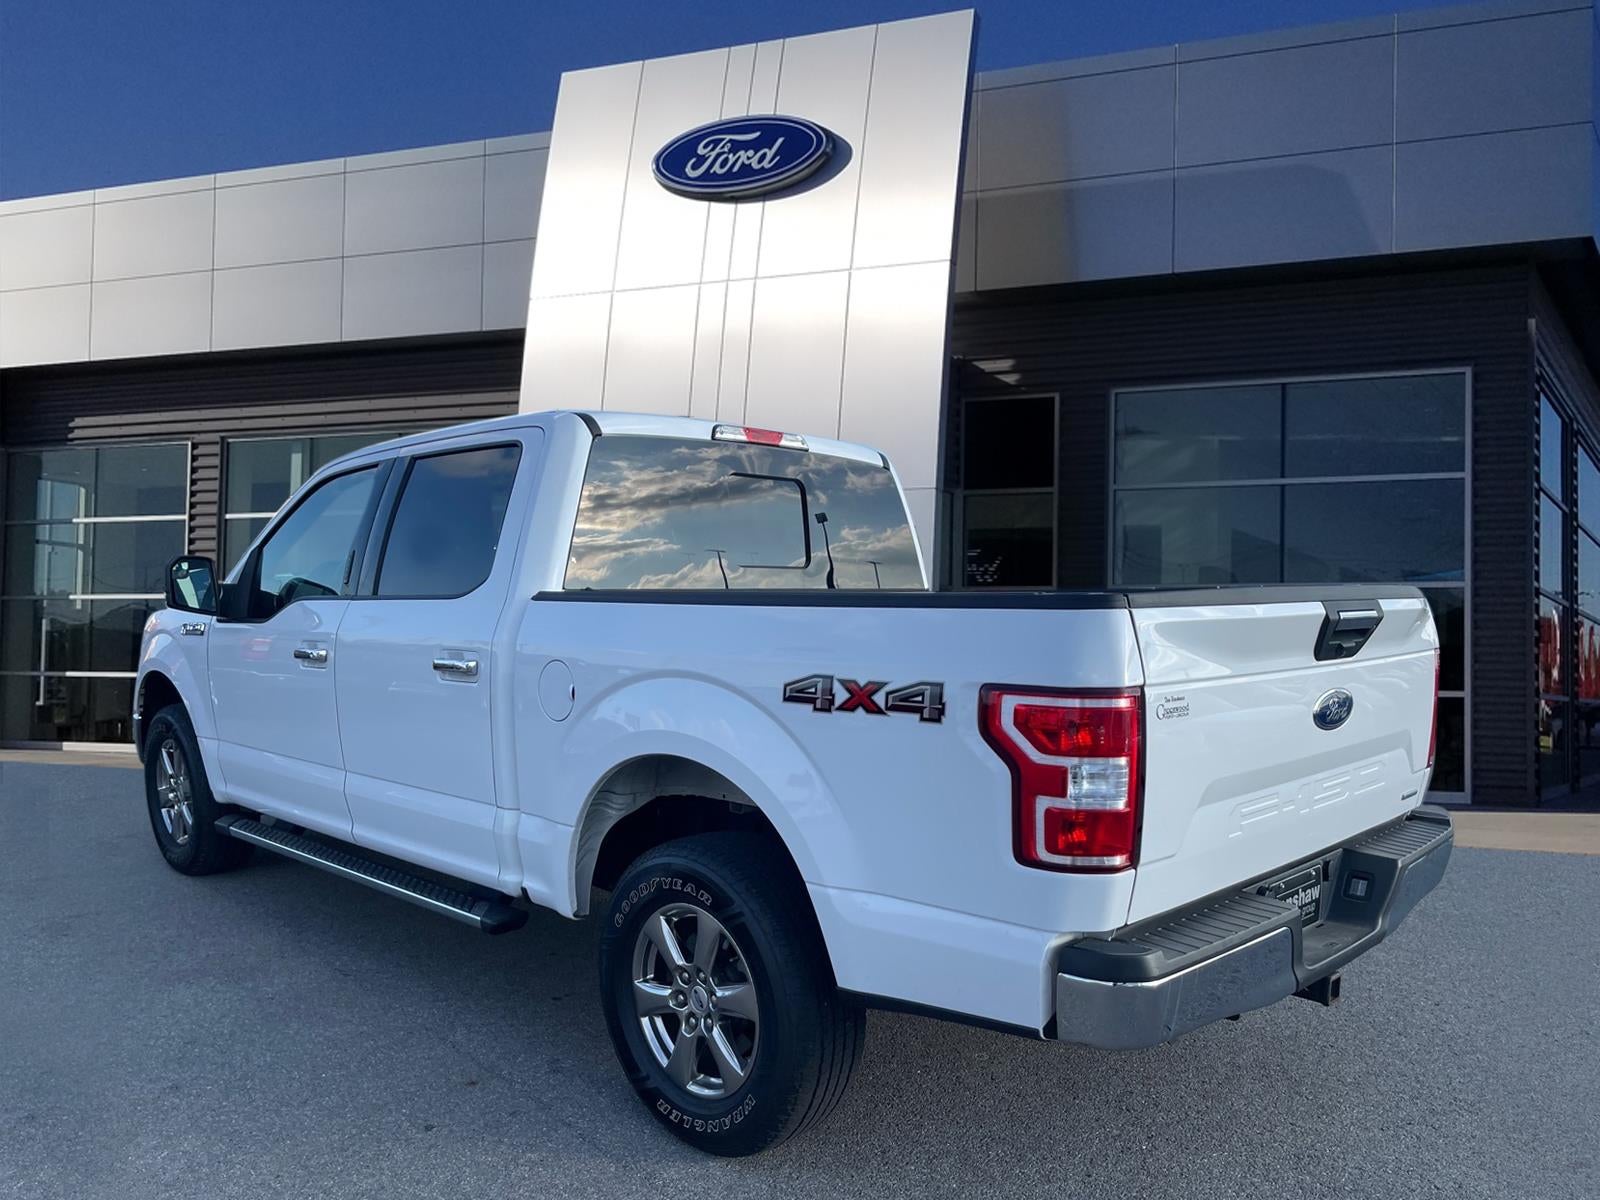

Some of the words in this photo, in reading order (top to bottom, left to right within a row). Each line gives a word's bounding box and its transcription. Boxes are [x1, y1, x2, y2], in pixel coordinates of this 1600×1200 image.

[685, 131, 785, 178] Ford
[614, 876, 713, 928] GOODYEAR
[656, 1094, 756, 1133] WRANGLER
